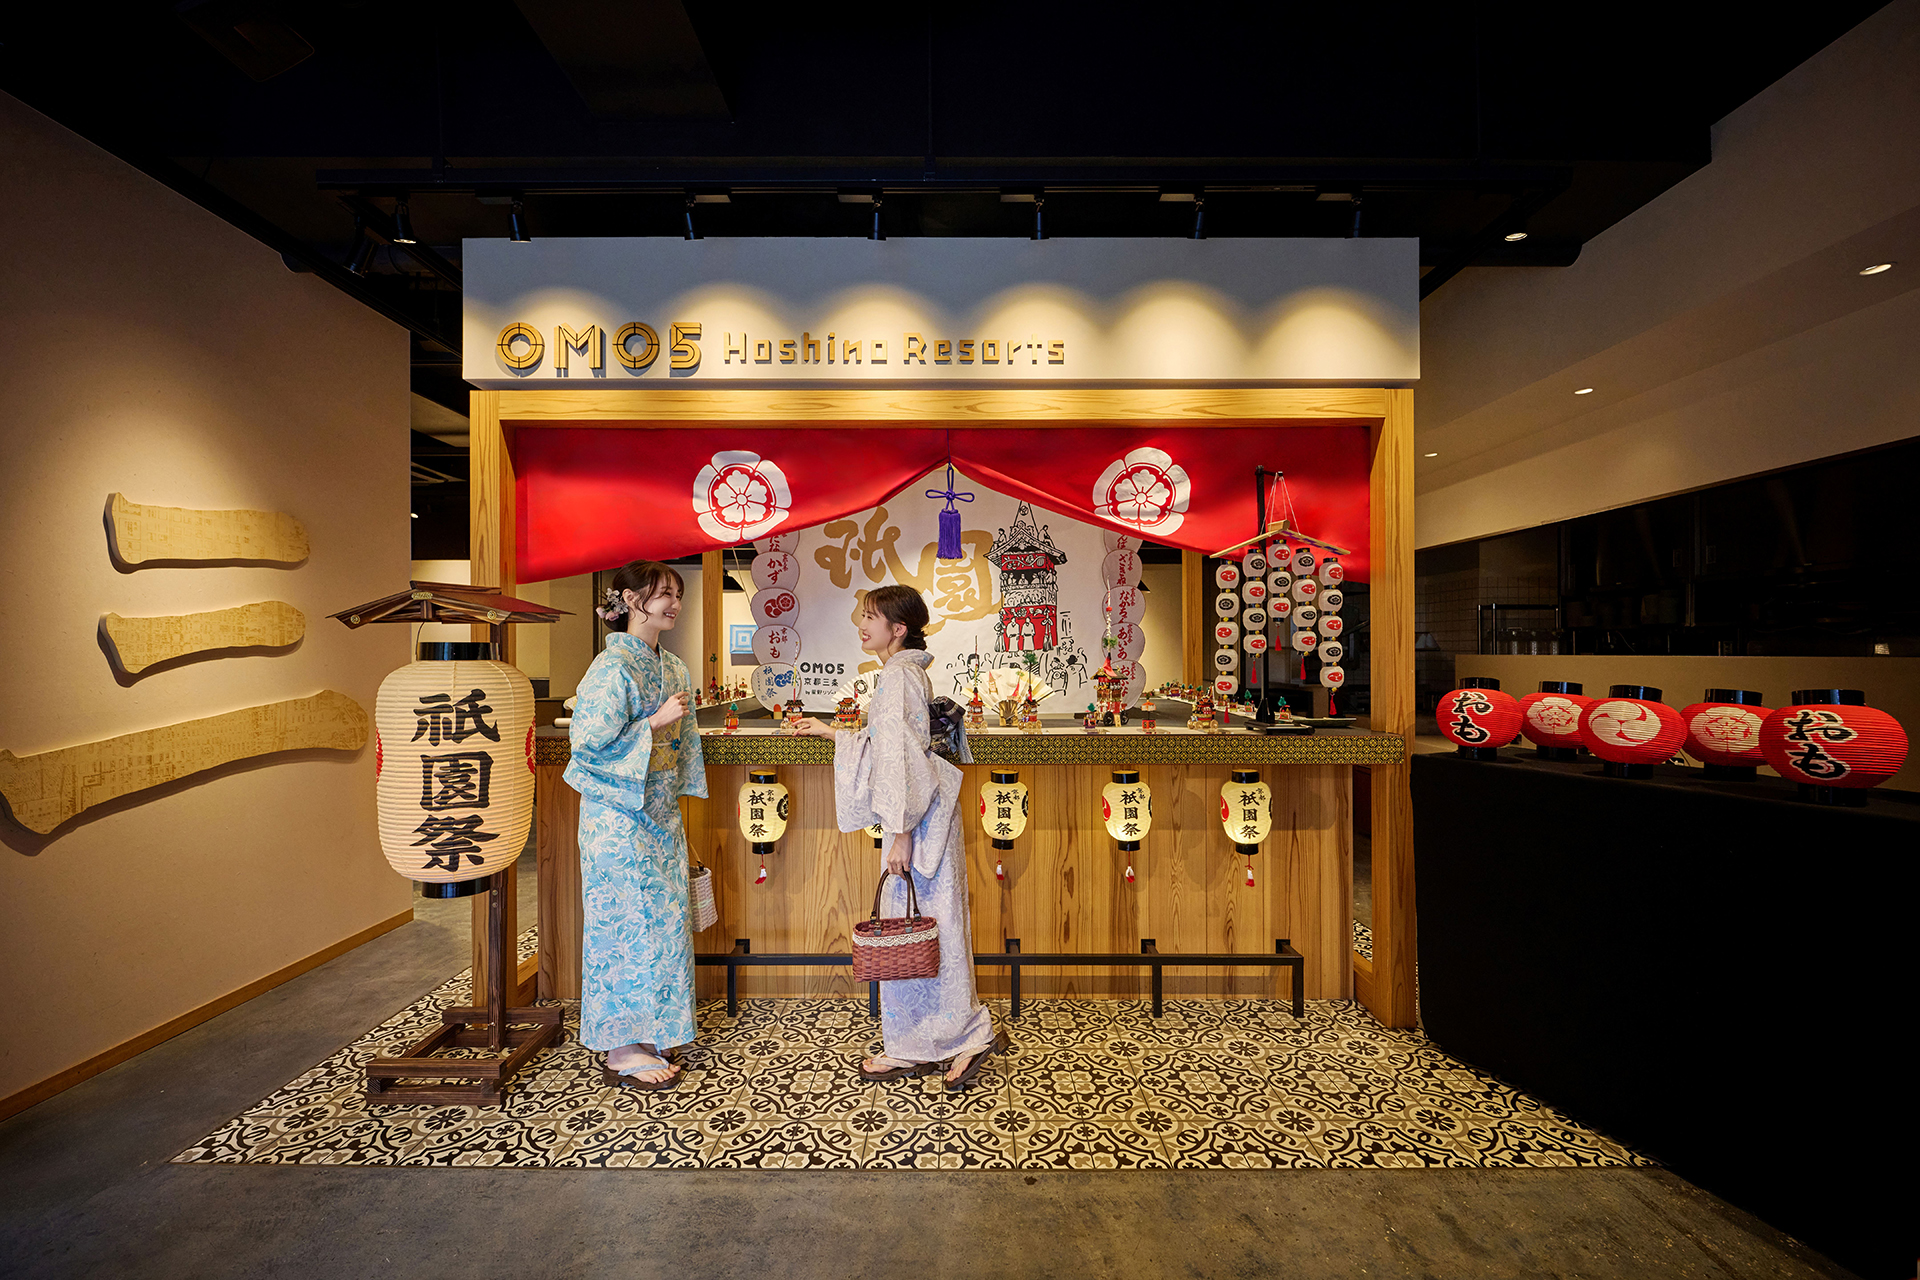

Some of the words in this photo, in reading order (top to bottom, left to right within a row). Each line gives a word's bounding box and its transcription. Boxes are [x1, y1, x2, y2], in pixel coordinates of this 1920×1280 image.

[496, 321, 702, 370] OMO5
[724, 331, 888, 364] Hoshino
[902, 331, 1065, 364] Resorts
[767, 558, 783, 585] かず
[768, 629, 781, 659] おも
[800, 662, 845, 675] OMO5
[803, 677, 839, 687] 京都三条
[1453, 691, 1494, 744] おも
[1784, 710, 1858, 780] おも
[409, 688, 501, 873] 祇園祭
[746, 789, 769, 838] 祇園祭
[993, 789, 1015, 836] 祇園祭
[1119, 789, 1142, 837] 祇園祭
[1239, 789, 1261, 839] 祇園祭
